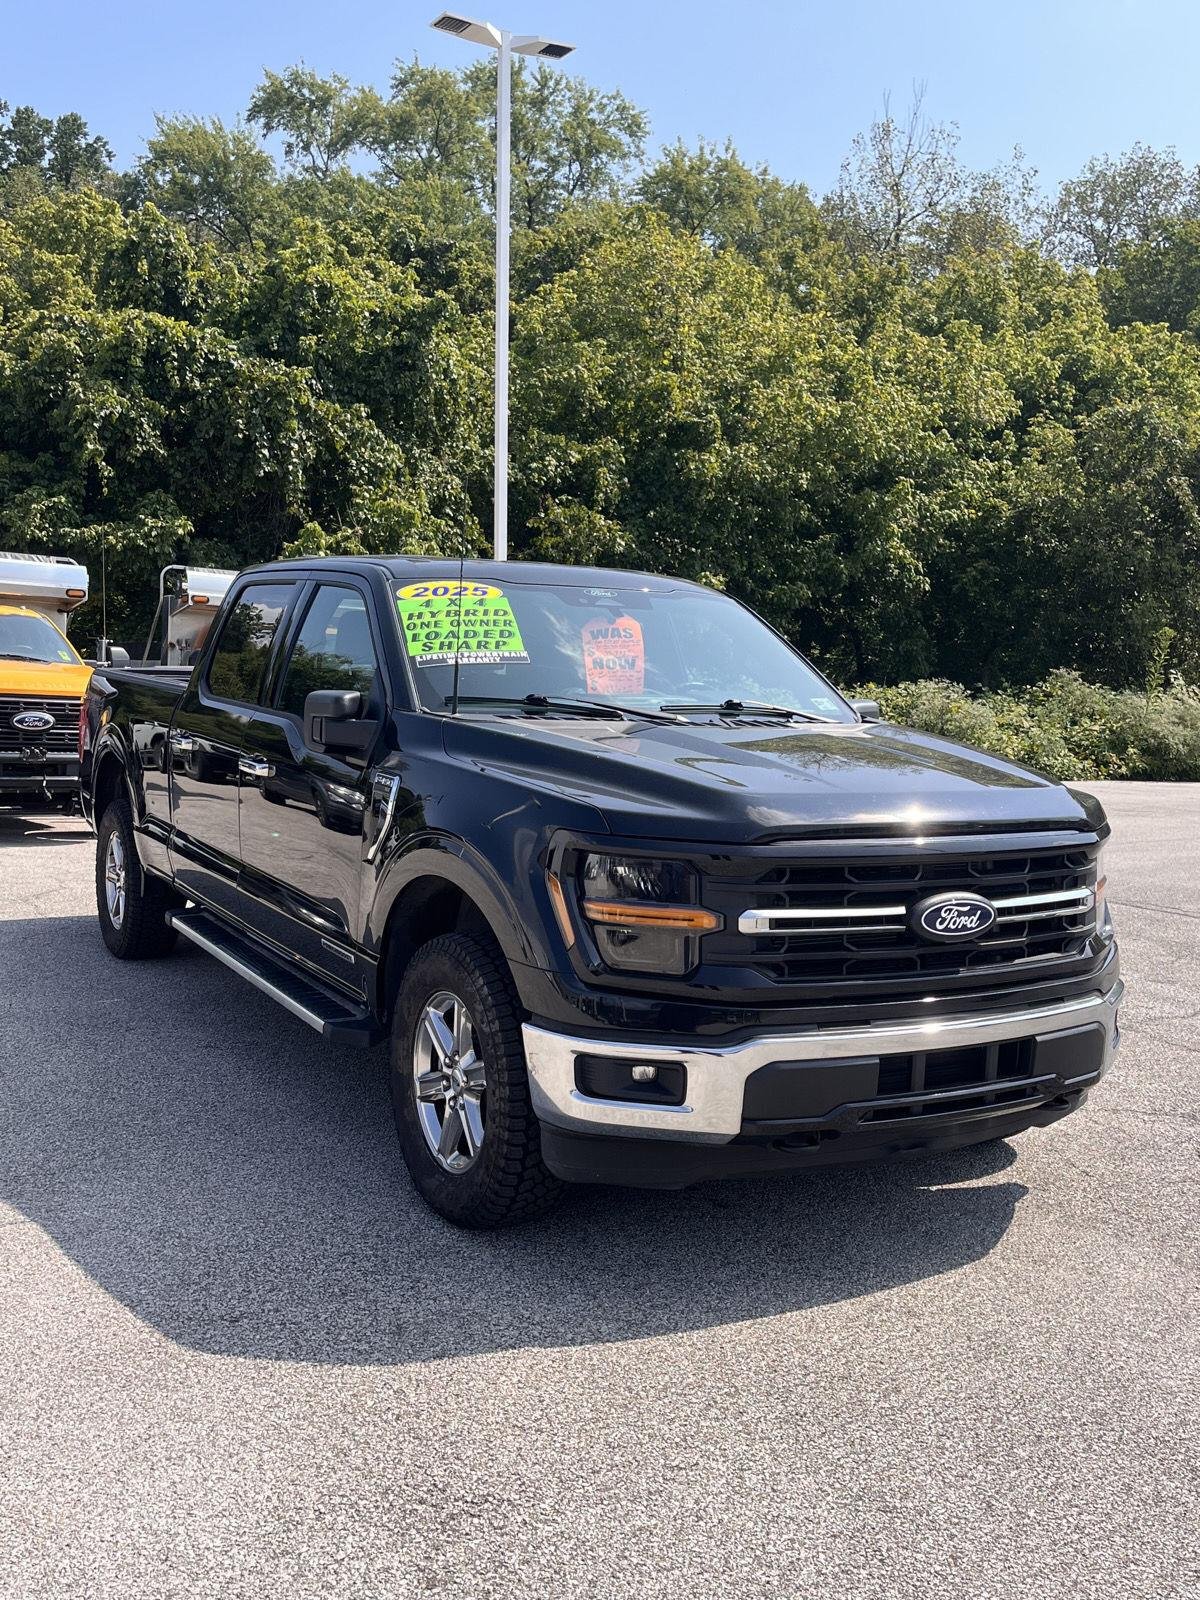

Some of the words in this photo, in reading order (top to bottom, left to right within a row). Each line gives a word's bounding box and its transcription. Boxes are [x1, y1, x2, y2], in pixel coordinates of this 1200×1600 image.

[411, 586, 489, 598] 2025
[419, 599, 433, 608] 4
[473, 598, 488, 606] 4
[407, 609, 509, 621] HYBRID
[406, 620, 443, 631] ONE
[450, 619, 512, 628] OWNER
[411, 629, 513, 643] LOADED
[589, 627, 634, 640] WAS
[421, 640, 508, 652] SHARP
[416, 652, 461, 661] LIFETIME
[463, 650, 528, 658] POWERTRAIN
[592, 657, 636, 670] NOW
[23, 717, 44, 727] Ford
[936, 905, 981, 930] Ford
